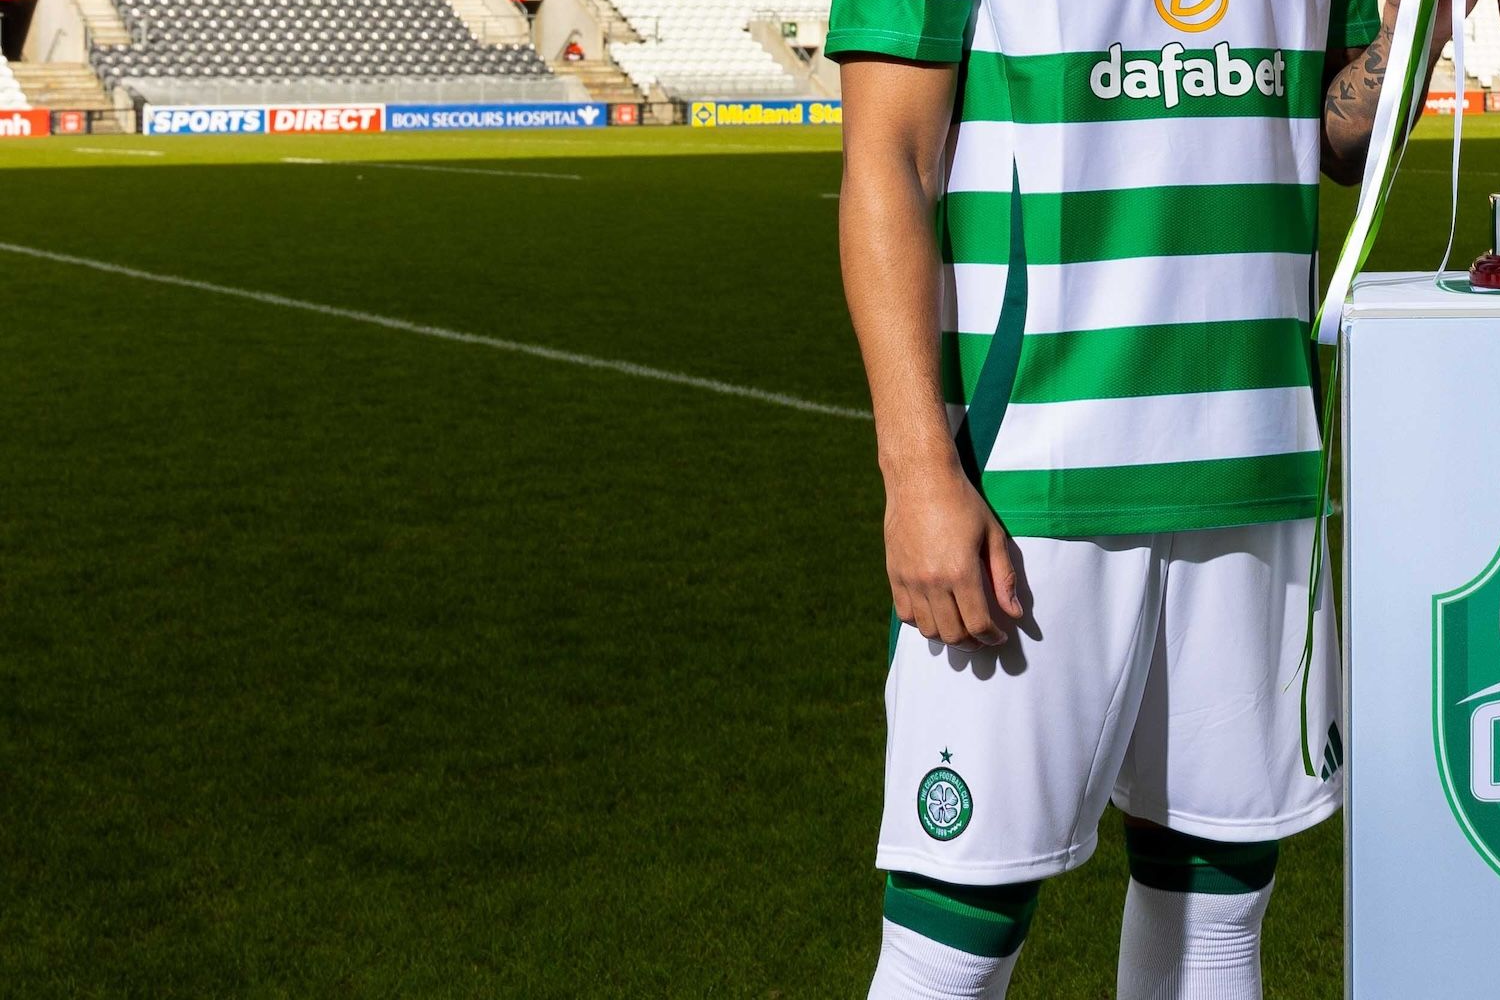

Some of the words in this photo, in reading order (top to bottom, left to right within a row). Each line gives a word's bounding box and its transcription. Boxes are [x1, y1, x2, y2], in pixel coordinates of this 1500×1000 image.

[1090, 41, 1285, 109] dafabet
[153, 110, 260, 133] SPORTS
[274, 108, 376, 131] DIRECT
[392, 112, 429, 128] BON
[432, 111, 504, 127] SECOURS
[507, 109, 578, 126] HOSPITAL
[717, 104, 803, 124] Midland
[924, 772, 939, 789] CELTIC
[939, 771, 963, 792] FOOTBALL
